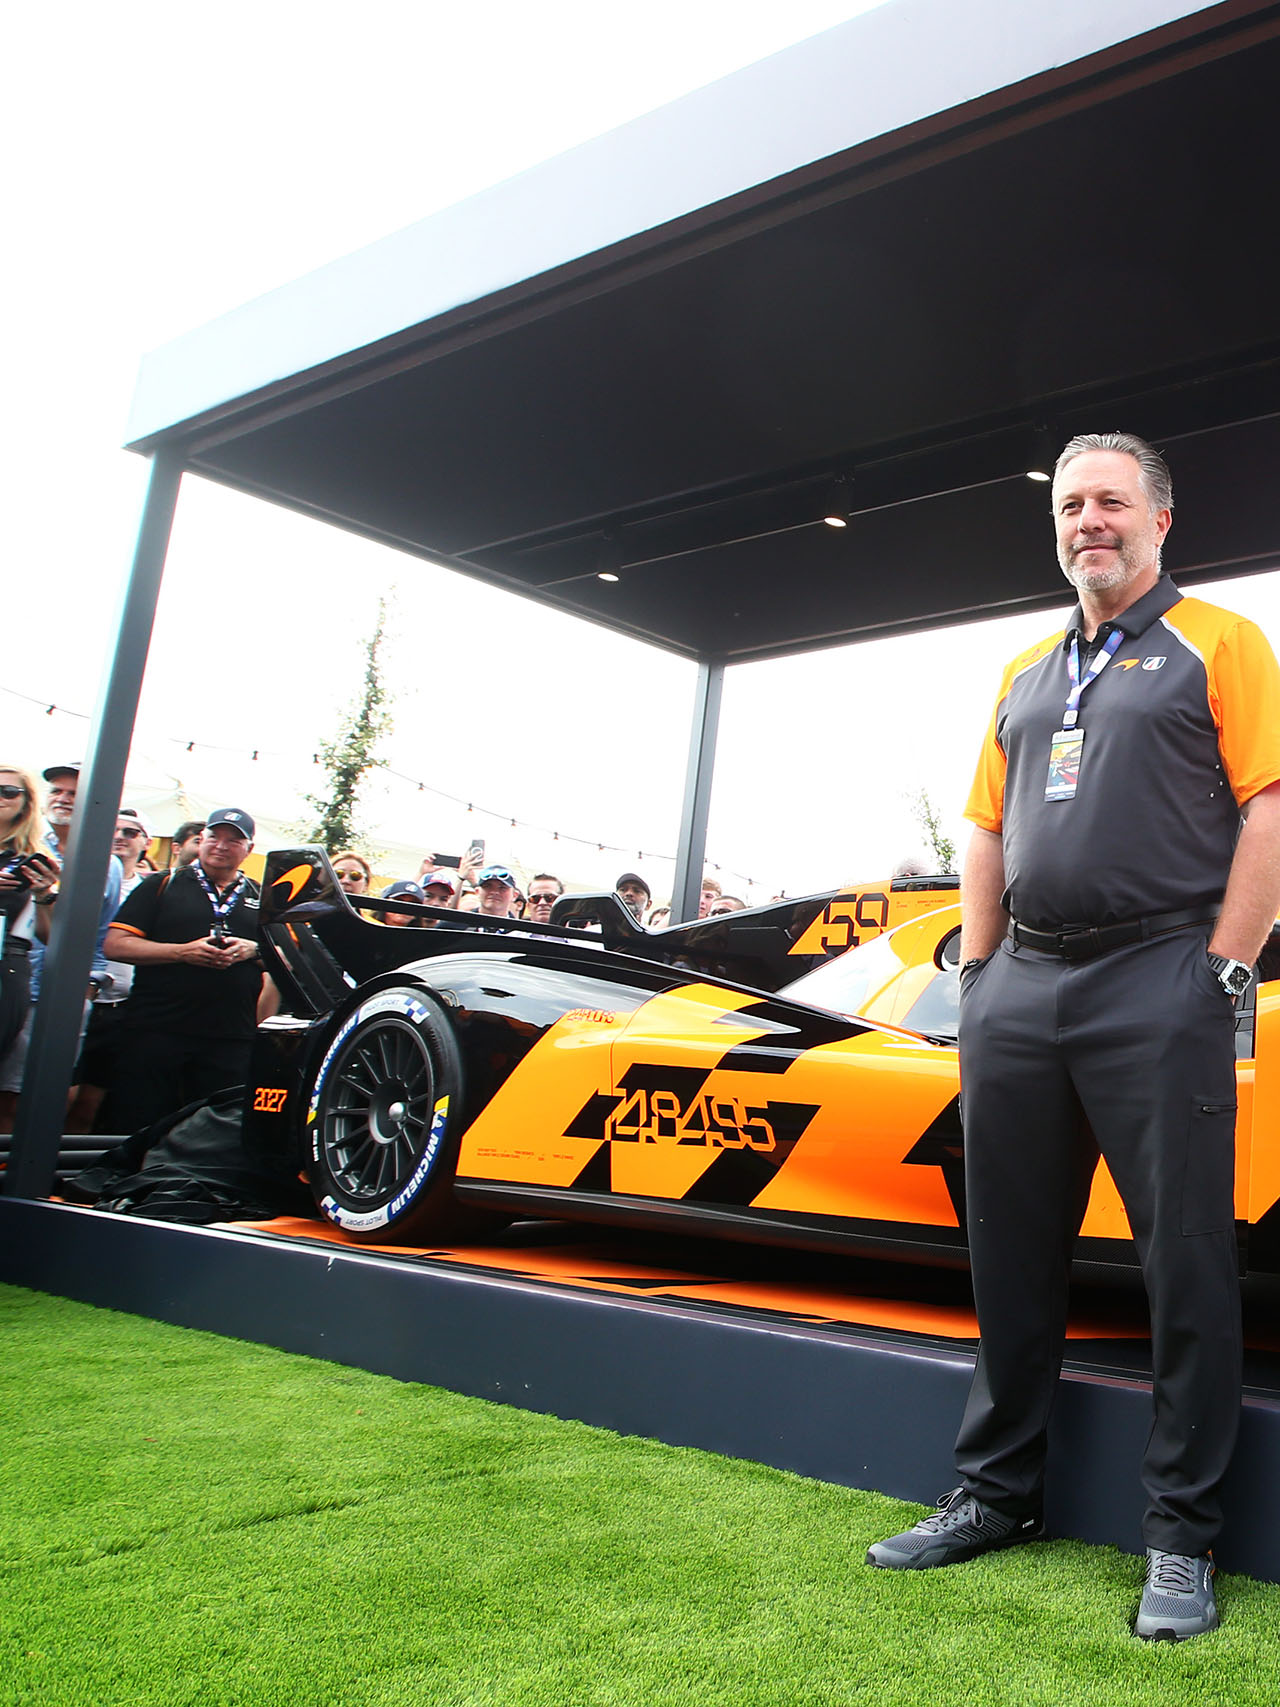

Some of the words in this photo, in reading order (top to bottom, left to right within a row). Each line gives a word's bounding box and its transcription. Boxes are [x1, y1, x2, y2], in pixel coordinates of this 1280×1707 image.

[821, 892, 889, 957] 59
[253, 1087, 288, 1112] 2027
[391, 1133, 439, 1215] MICHELIN
